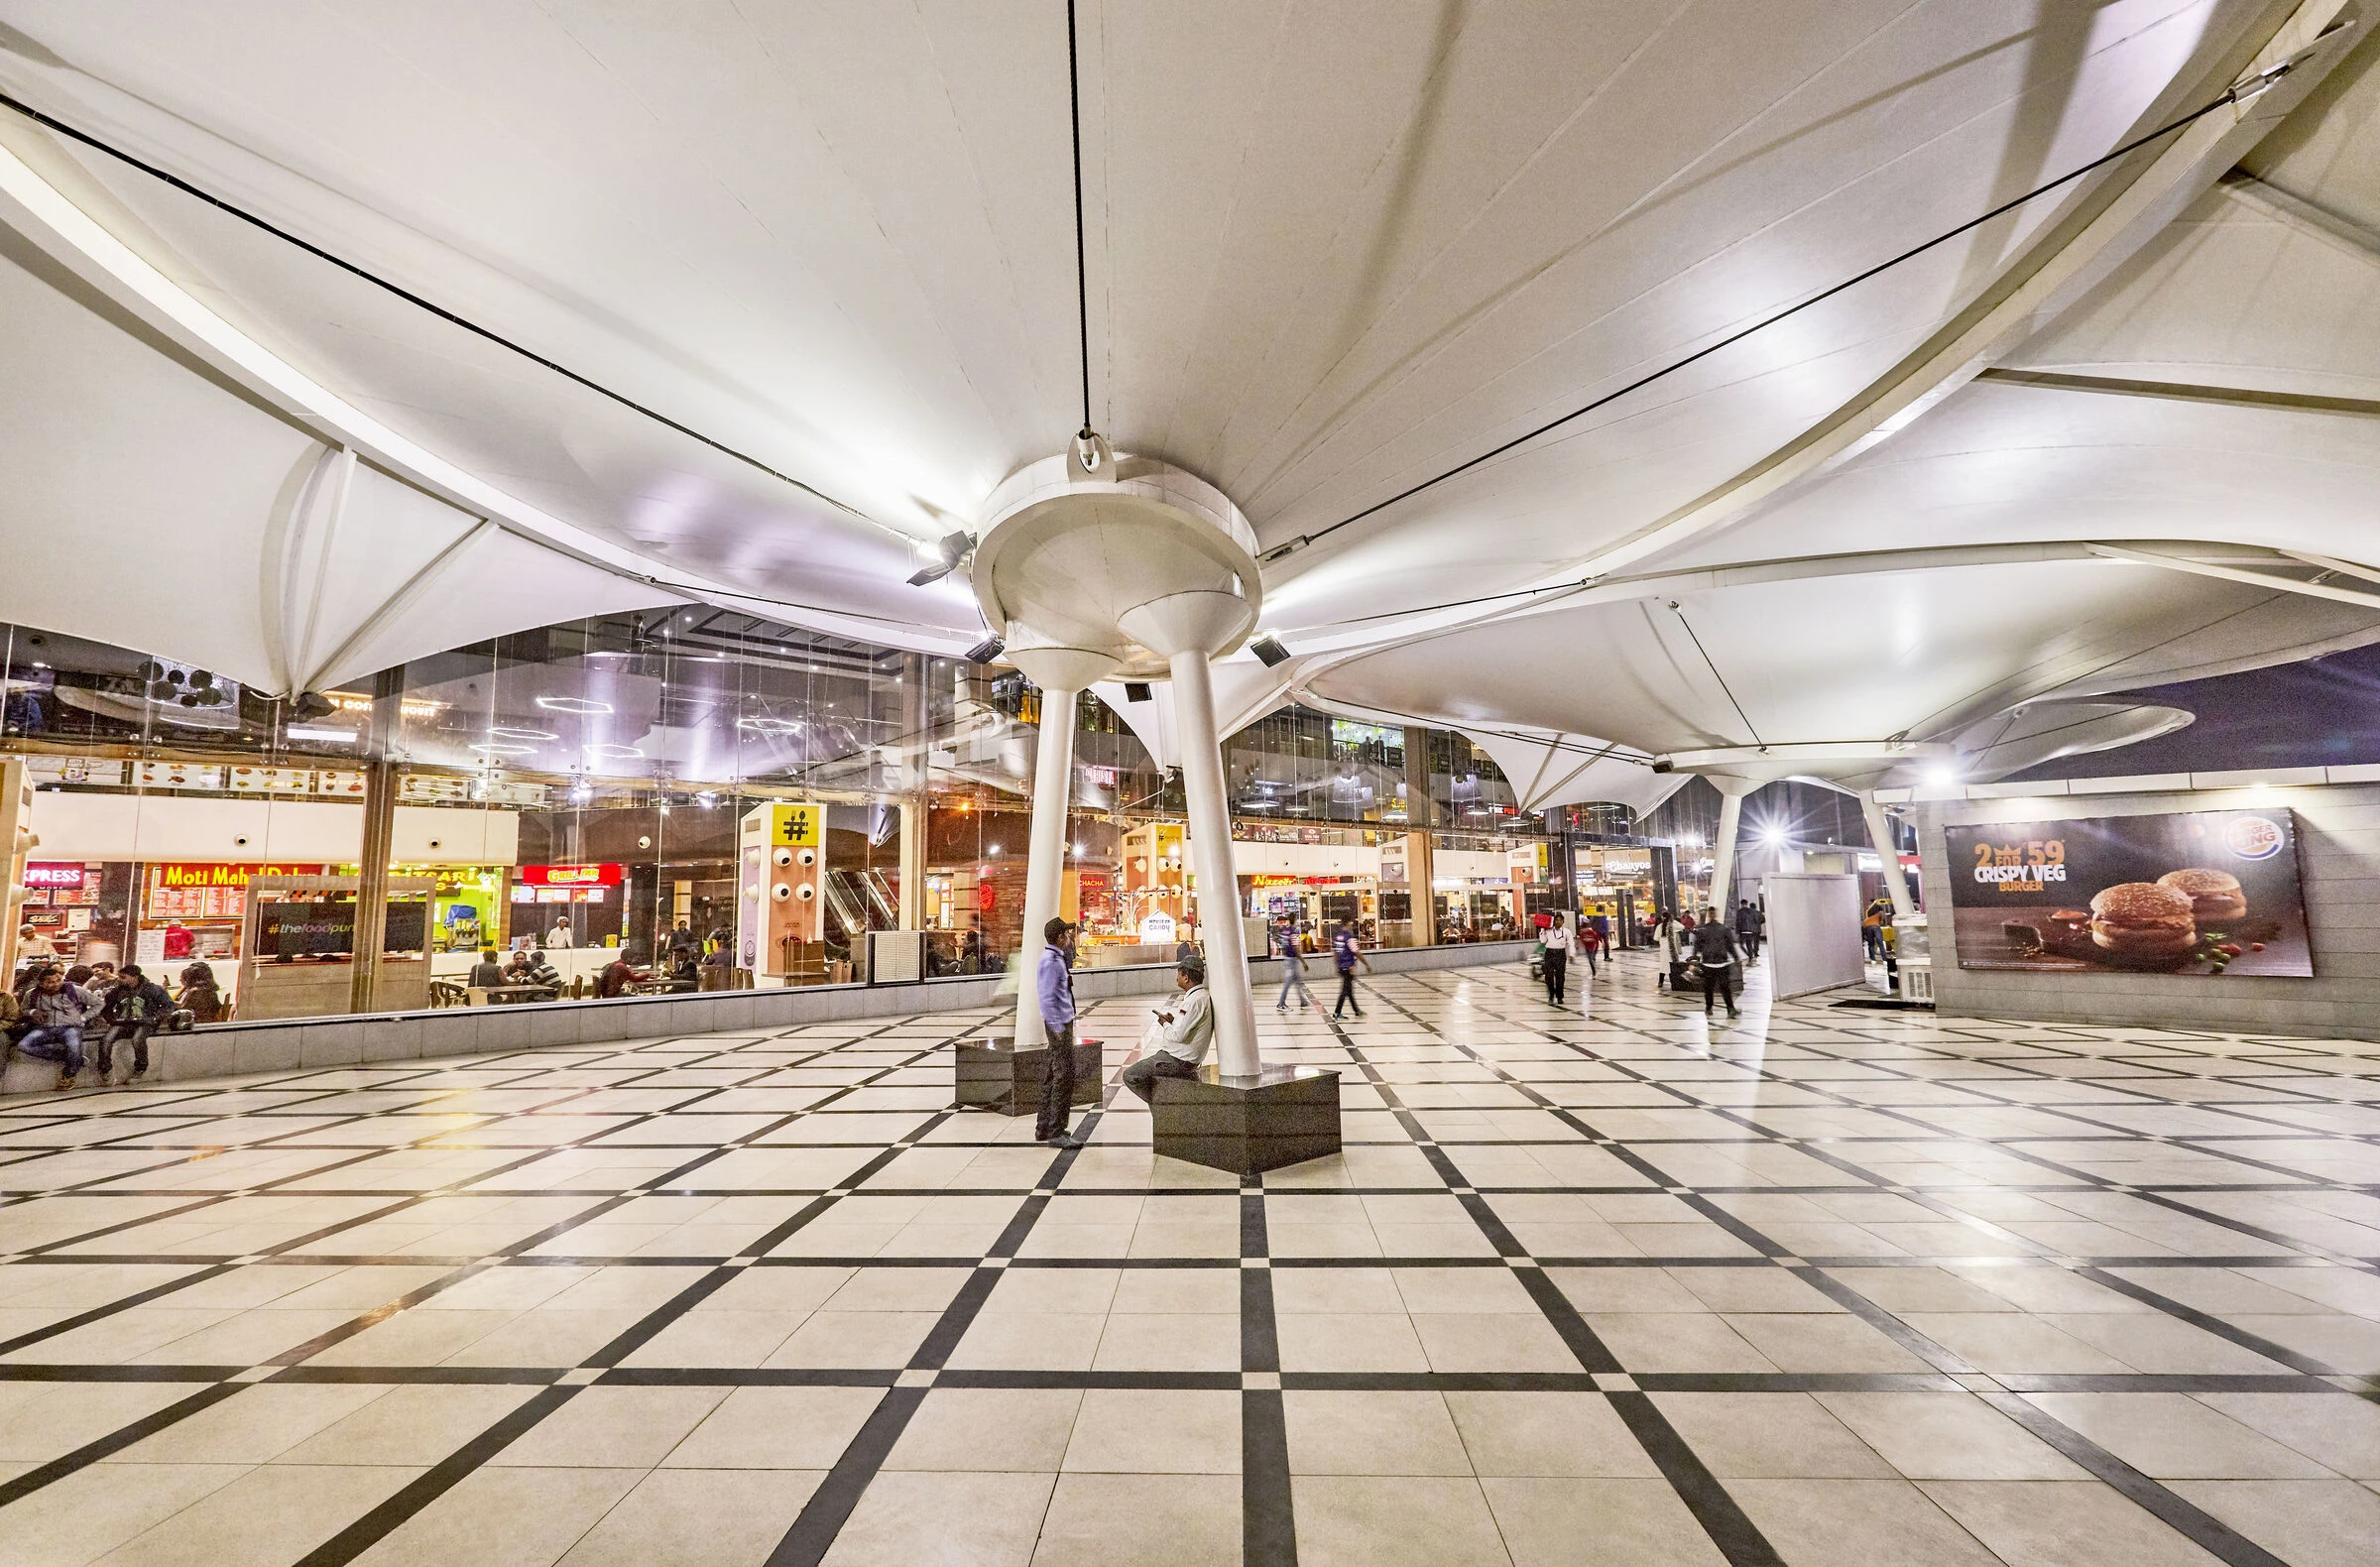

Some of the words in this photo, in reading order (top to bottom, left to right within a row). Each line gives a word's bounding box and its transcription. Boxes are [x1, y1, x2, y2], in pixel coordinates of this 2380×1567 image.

[1975, 843, 1992, 867] 2
[166, 866, 208, 886] Moti
[212, 866, 264, 886] Mahl
[1974, 865, 2029, 883] CRISPY
[2032, 864, 2067, 882] VEG
[1999, 881, 2044, 892] BURGER
